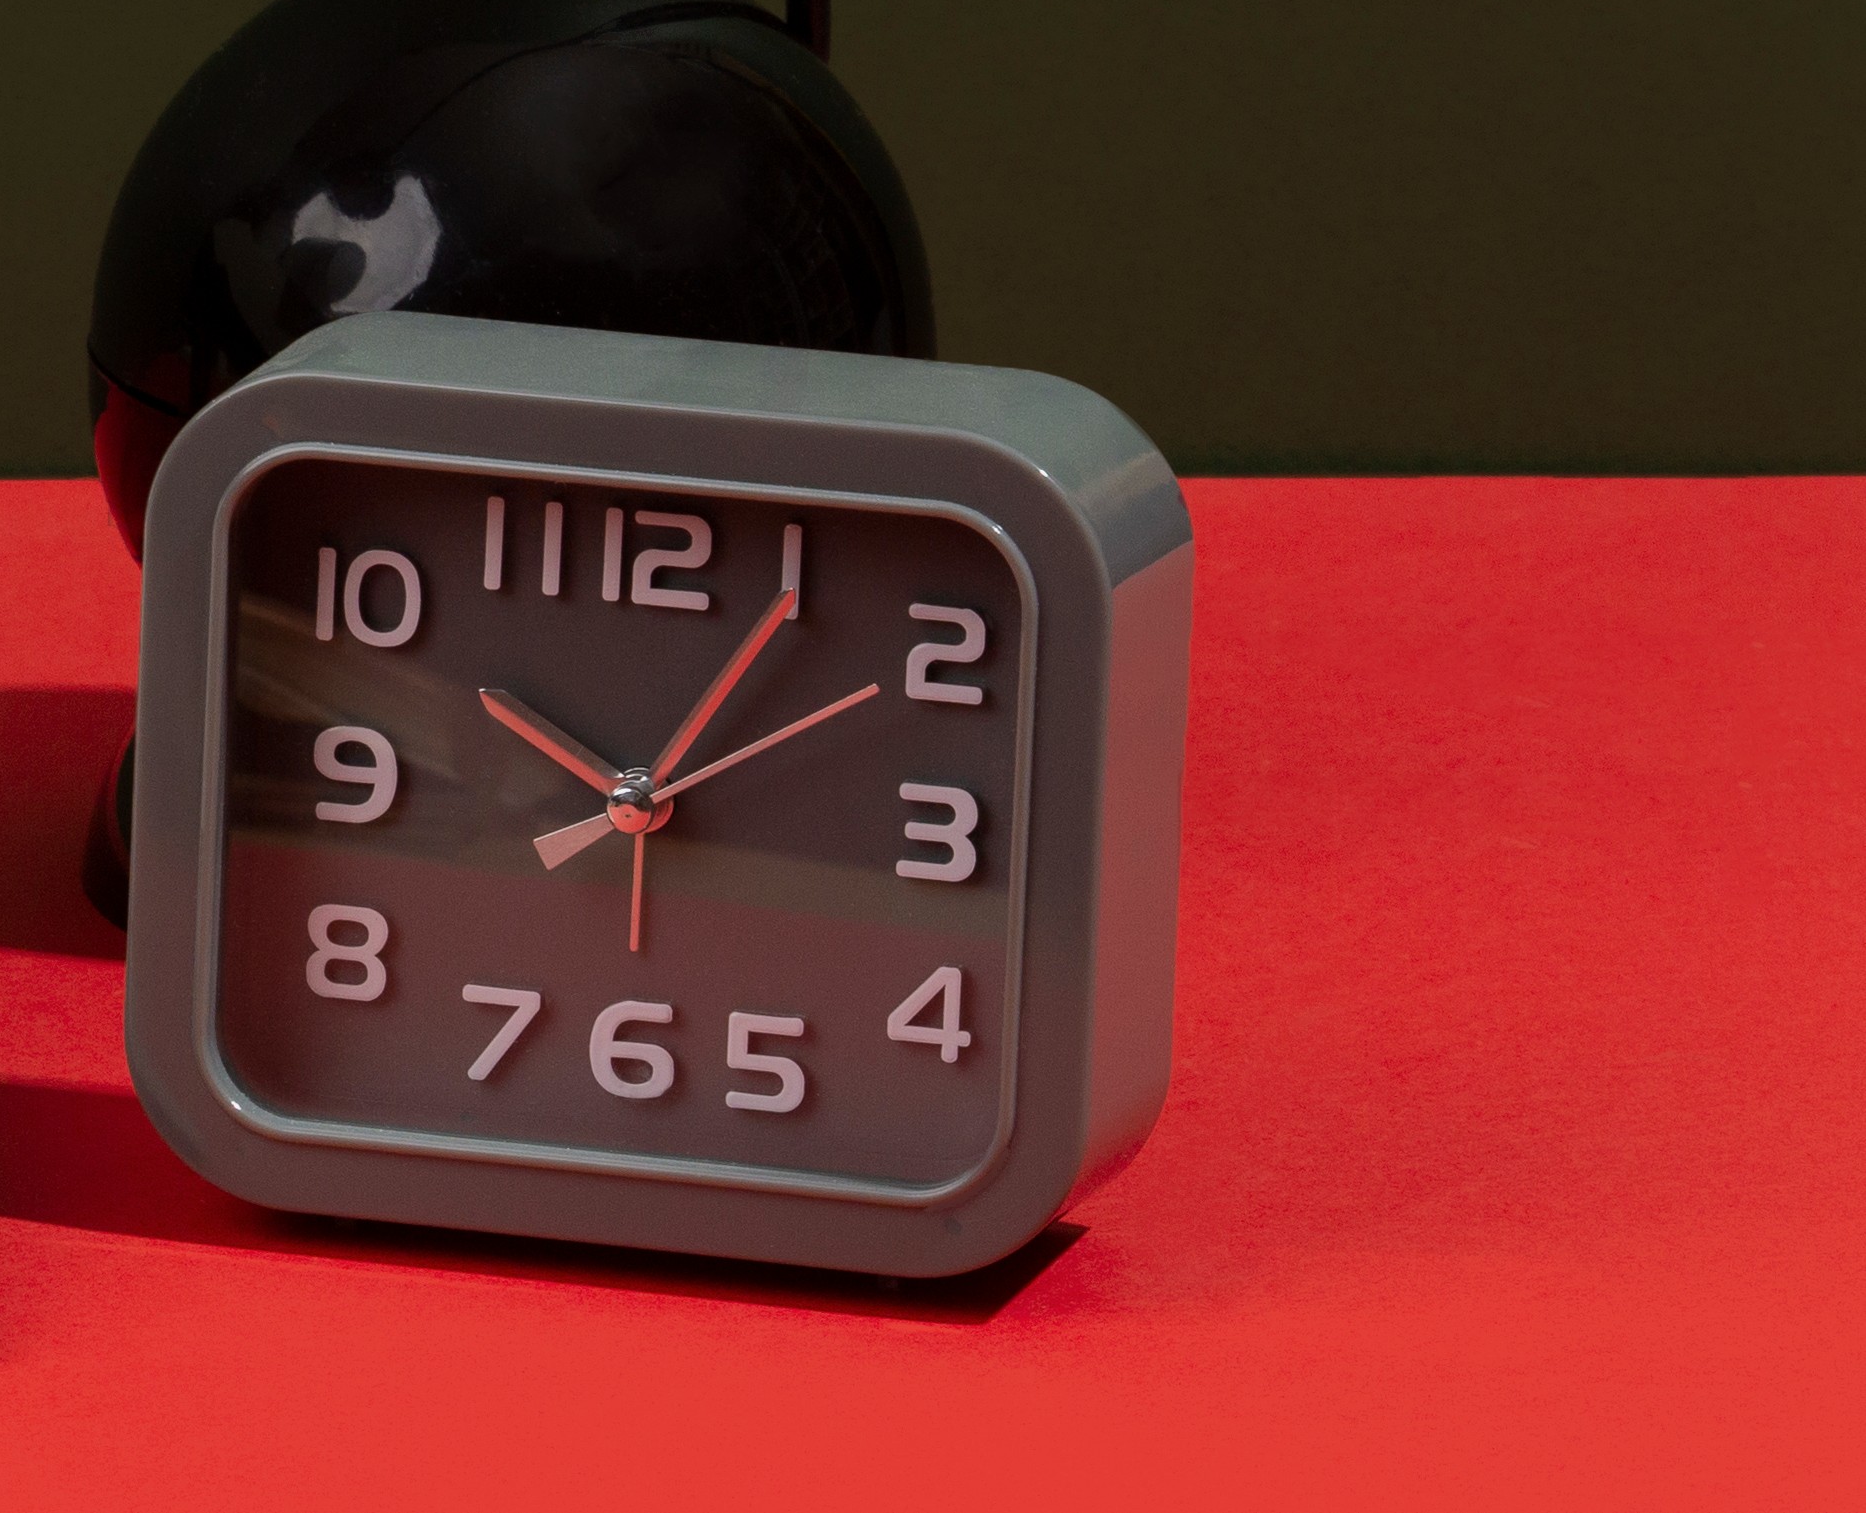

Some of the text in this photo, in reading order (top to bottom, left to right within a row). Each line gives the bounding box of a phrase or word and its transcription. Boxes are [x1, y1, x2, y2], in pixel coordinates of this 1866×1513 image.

[482, 496, 563, 596] 11
[601, 506, 713, 611] 12
[315, 546, 422, 648] 10
[904, 602, 987, 705] 2
[313, 724, 399, 824] 9
[895, 782, 980, 883] 3
[305, 903, 390, 1002] 8
[462, 983, 541, 1081] 7
[588, 999, 674, 1100] 6
[725, 1010, 805, 1113] 5
[886, 966, 971, 1063] 4
